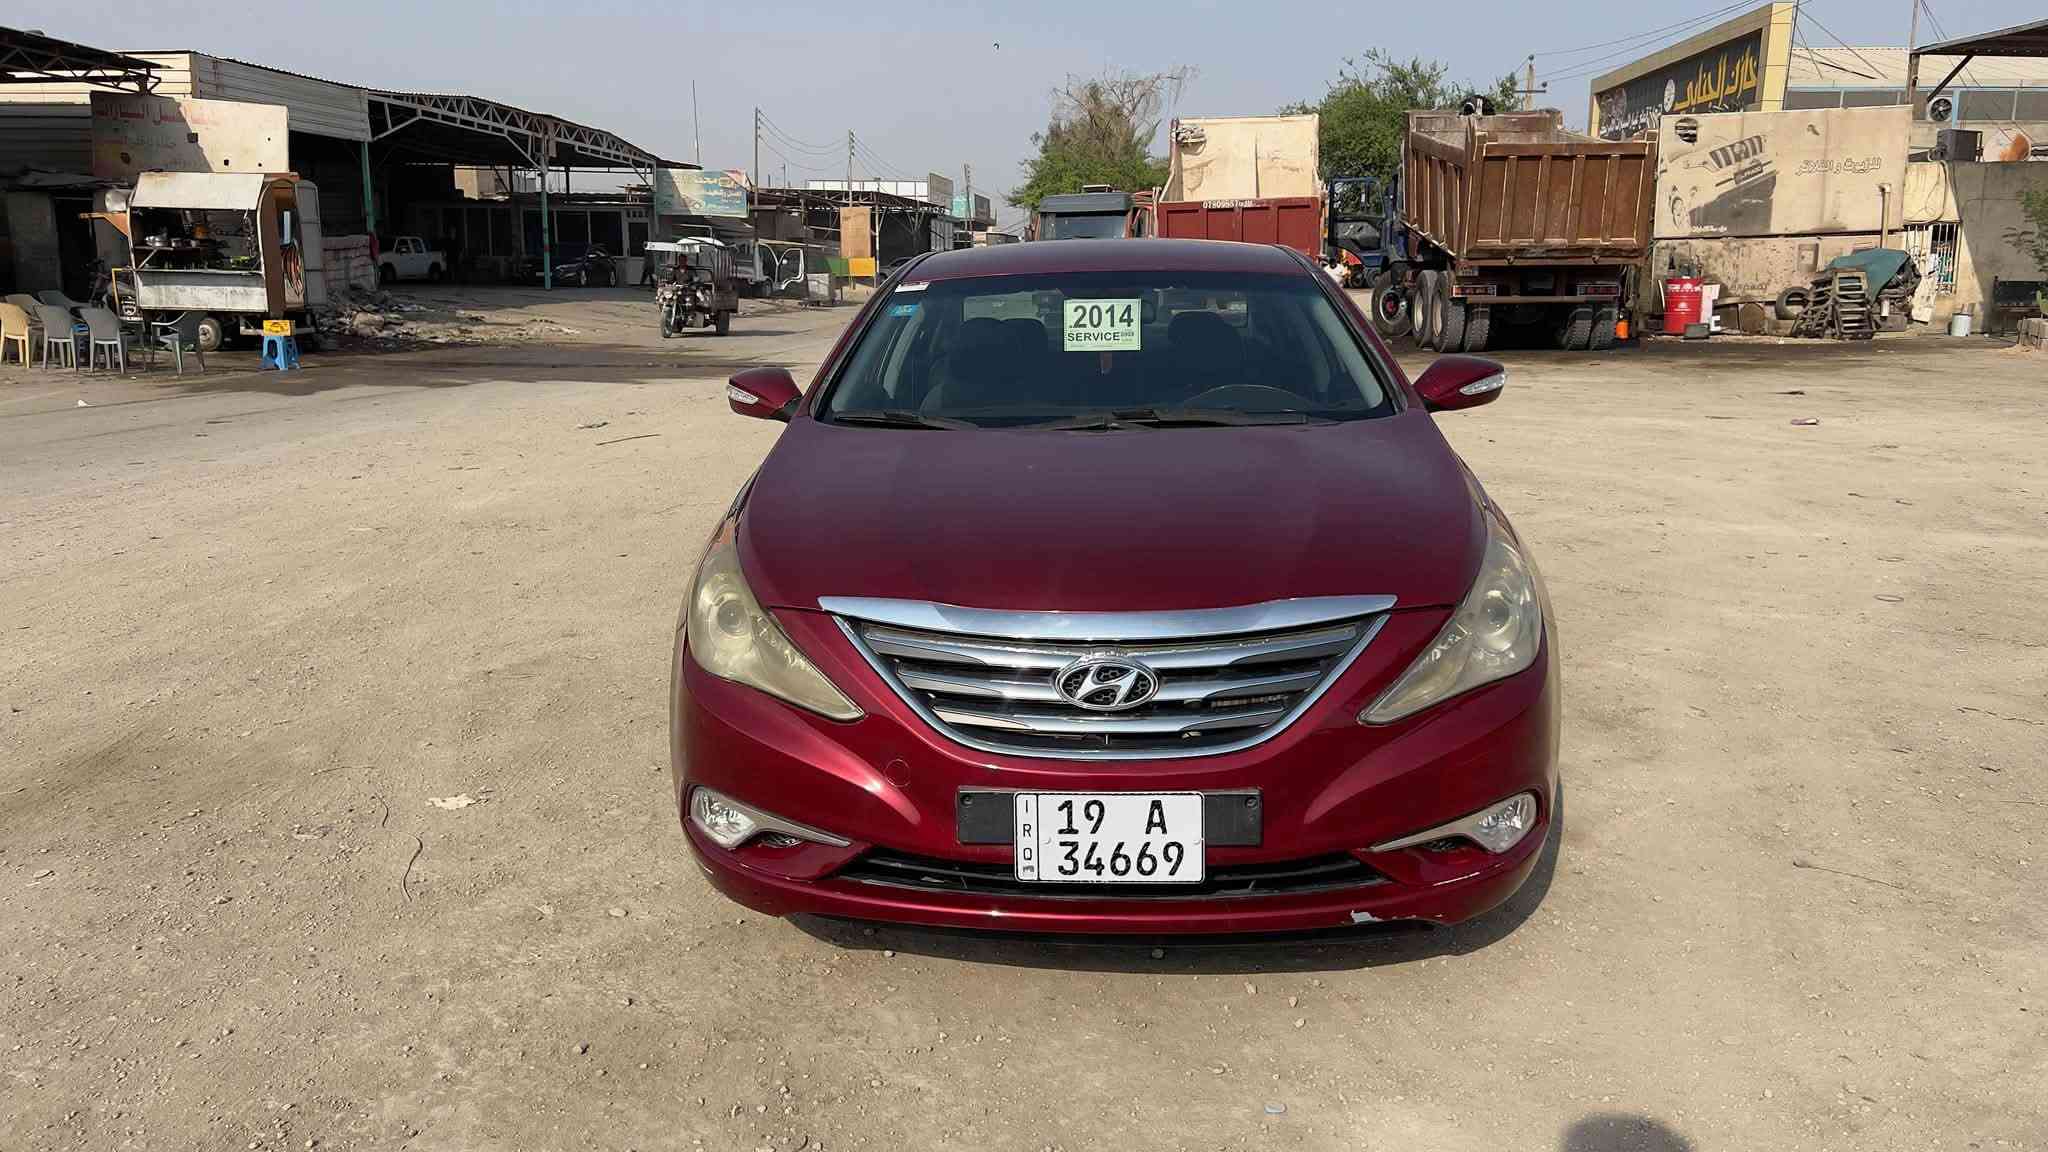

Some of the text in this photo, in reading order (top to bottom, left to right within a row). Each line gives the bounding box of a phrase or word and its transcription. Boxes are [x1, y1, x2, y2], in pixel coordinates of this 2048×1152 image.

[1067, 331, 1121, 342] SERVICE
[1057, 799, 1168, 835] 19 A
[1057, 841, 1185, 876] 34669
